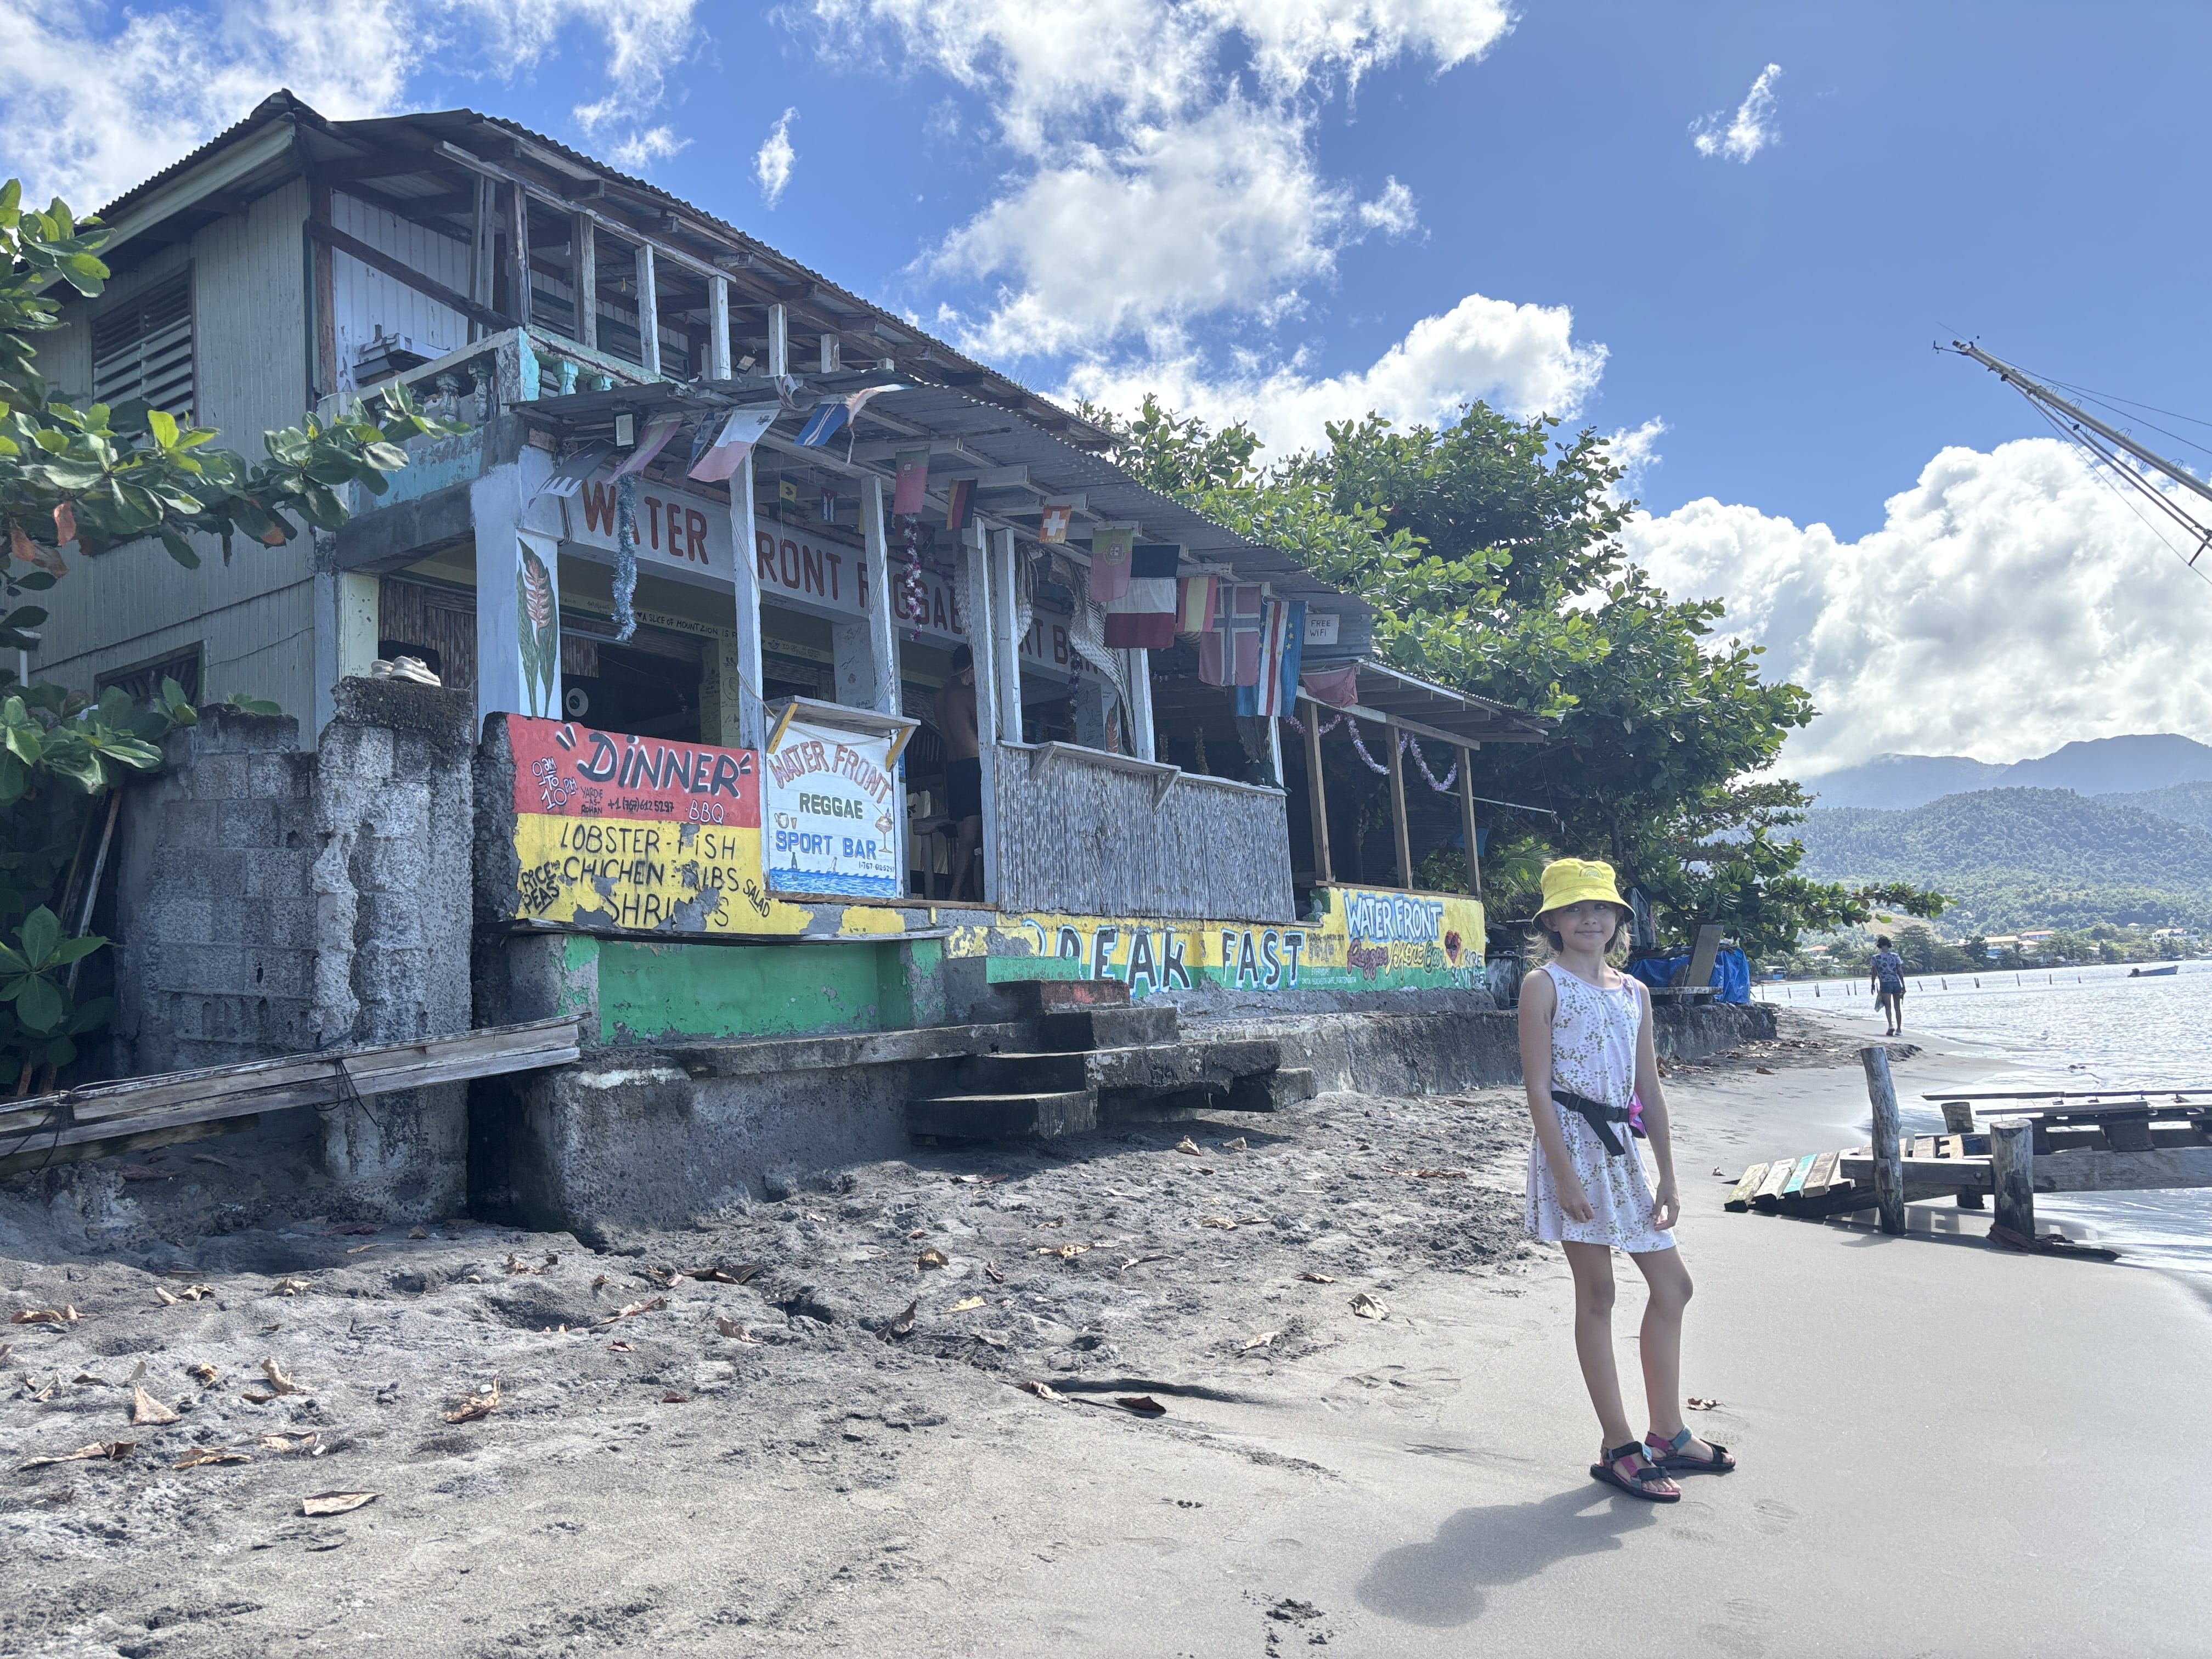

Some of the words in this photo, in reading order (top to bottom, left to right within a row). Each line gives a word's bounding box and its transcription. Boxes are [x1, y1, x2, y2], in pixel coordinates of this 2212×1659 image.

[582, 479, 709, 565] WTER
[755, 530, 842, 601] RONT
[1311, 619, 1331, 628] FREE
[768, 741, 830, 789] WATER
[831, 744, 893, 804] FRONT
[799, 792, 864, 820] REGGAE
[560, 822, 660, 854] LOBSTER
[775, 830, 833, 855] SPORT
[843, 836, 877, 860] BAR
[523, 879, 560, 915] PEAS
[605, 893, 729, 927] SHRIS
[743, 878, 770, 918] SALAD
[1344, 893, 1394, 939] WATER
[1393, 894, 1443, 940] FRONT
[1221, 926, 1306, 993] FAST
[1347, 937, 1389, 981] Reggae
[1424, 939, 1447, 974] Bar
